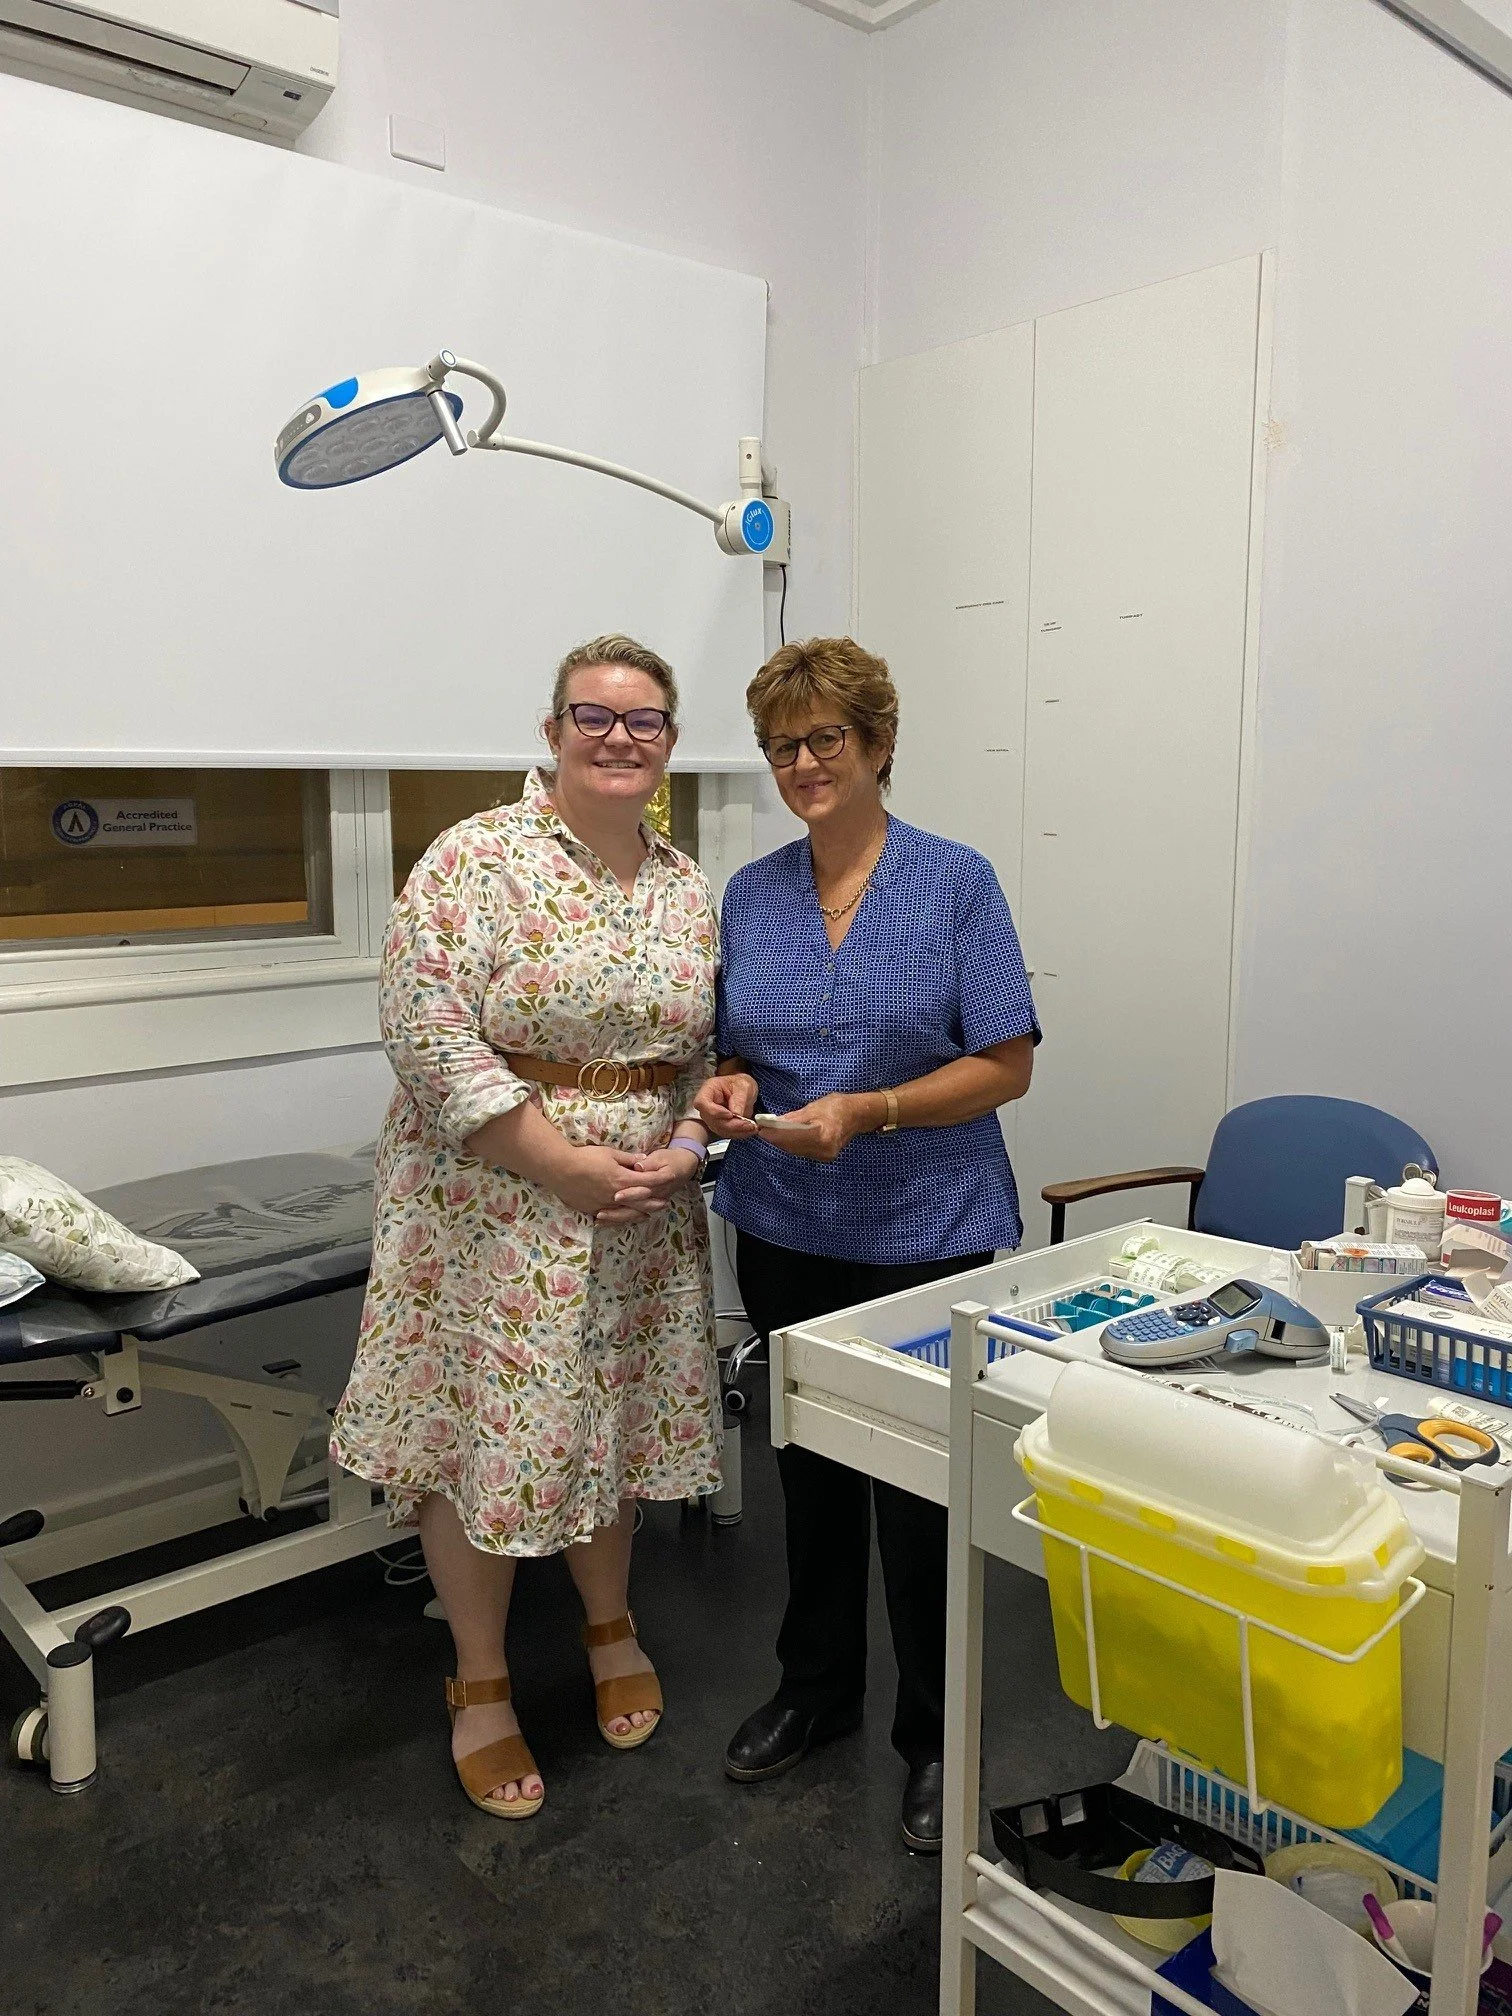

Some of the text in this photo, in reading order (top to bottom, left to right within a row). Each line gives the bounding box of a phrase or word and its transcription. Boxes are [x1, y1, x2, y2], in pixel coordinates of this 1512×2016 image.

[116, 810, 178, 820] Accredited
[102, 822, 192, 833] General Practice
[1448, 1201, 1495, 1216] Leukoplast
